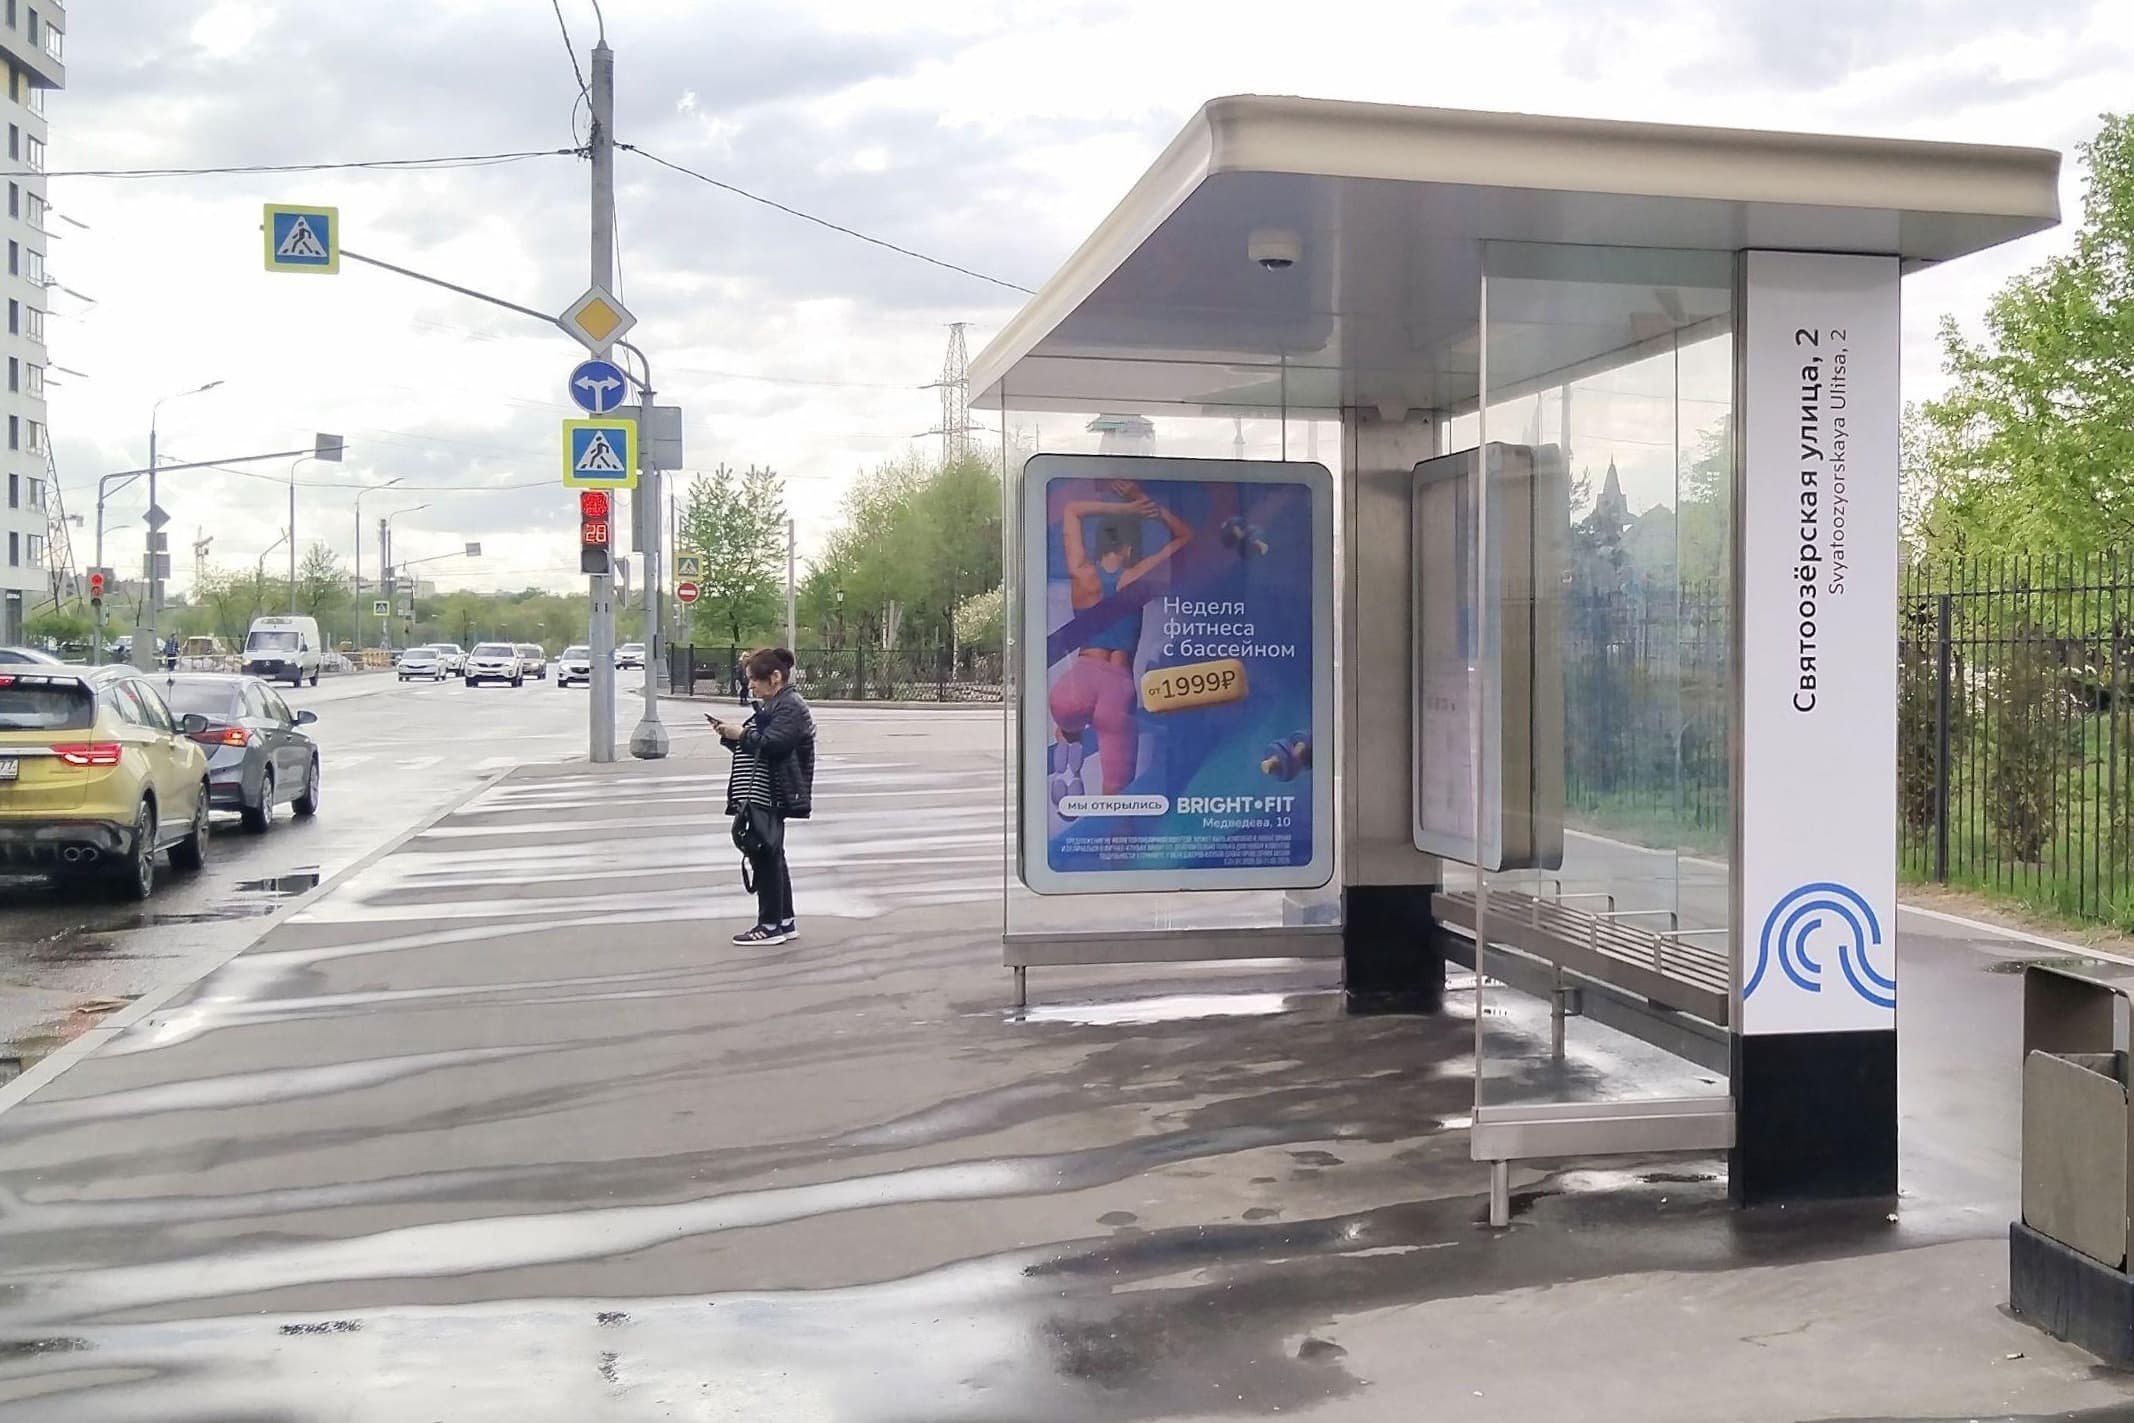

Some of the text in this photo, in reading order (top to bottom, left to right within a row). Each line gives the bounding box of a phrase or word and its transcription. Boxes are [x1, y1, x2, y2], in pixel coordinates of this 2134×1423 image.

[1829, 329, 1849, 595] Svyatoozyorskaya Ulitsa, 2
[1793, 328, 1824, 713] Святоозёрская улица, 2
[585, 524, 607, 543] 28
[1163, 596, 1245, 617] Неделя
[1163, 617, 1255, 639] фитнеса
[1163, 639, 1296, 657] с бассейном
[1148, 670, 1236, 699] от 1999₽
[1067, 800, 1163, 812] мы открылись
[1202, 817, 1292, 829] Медведева, 10
